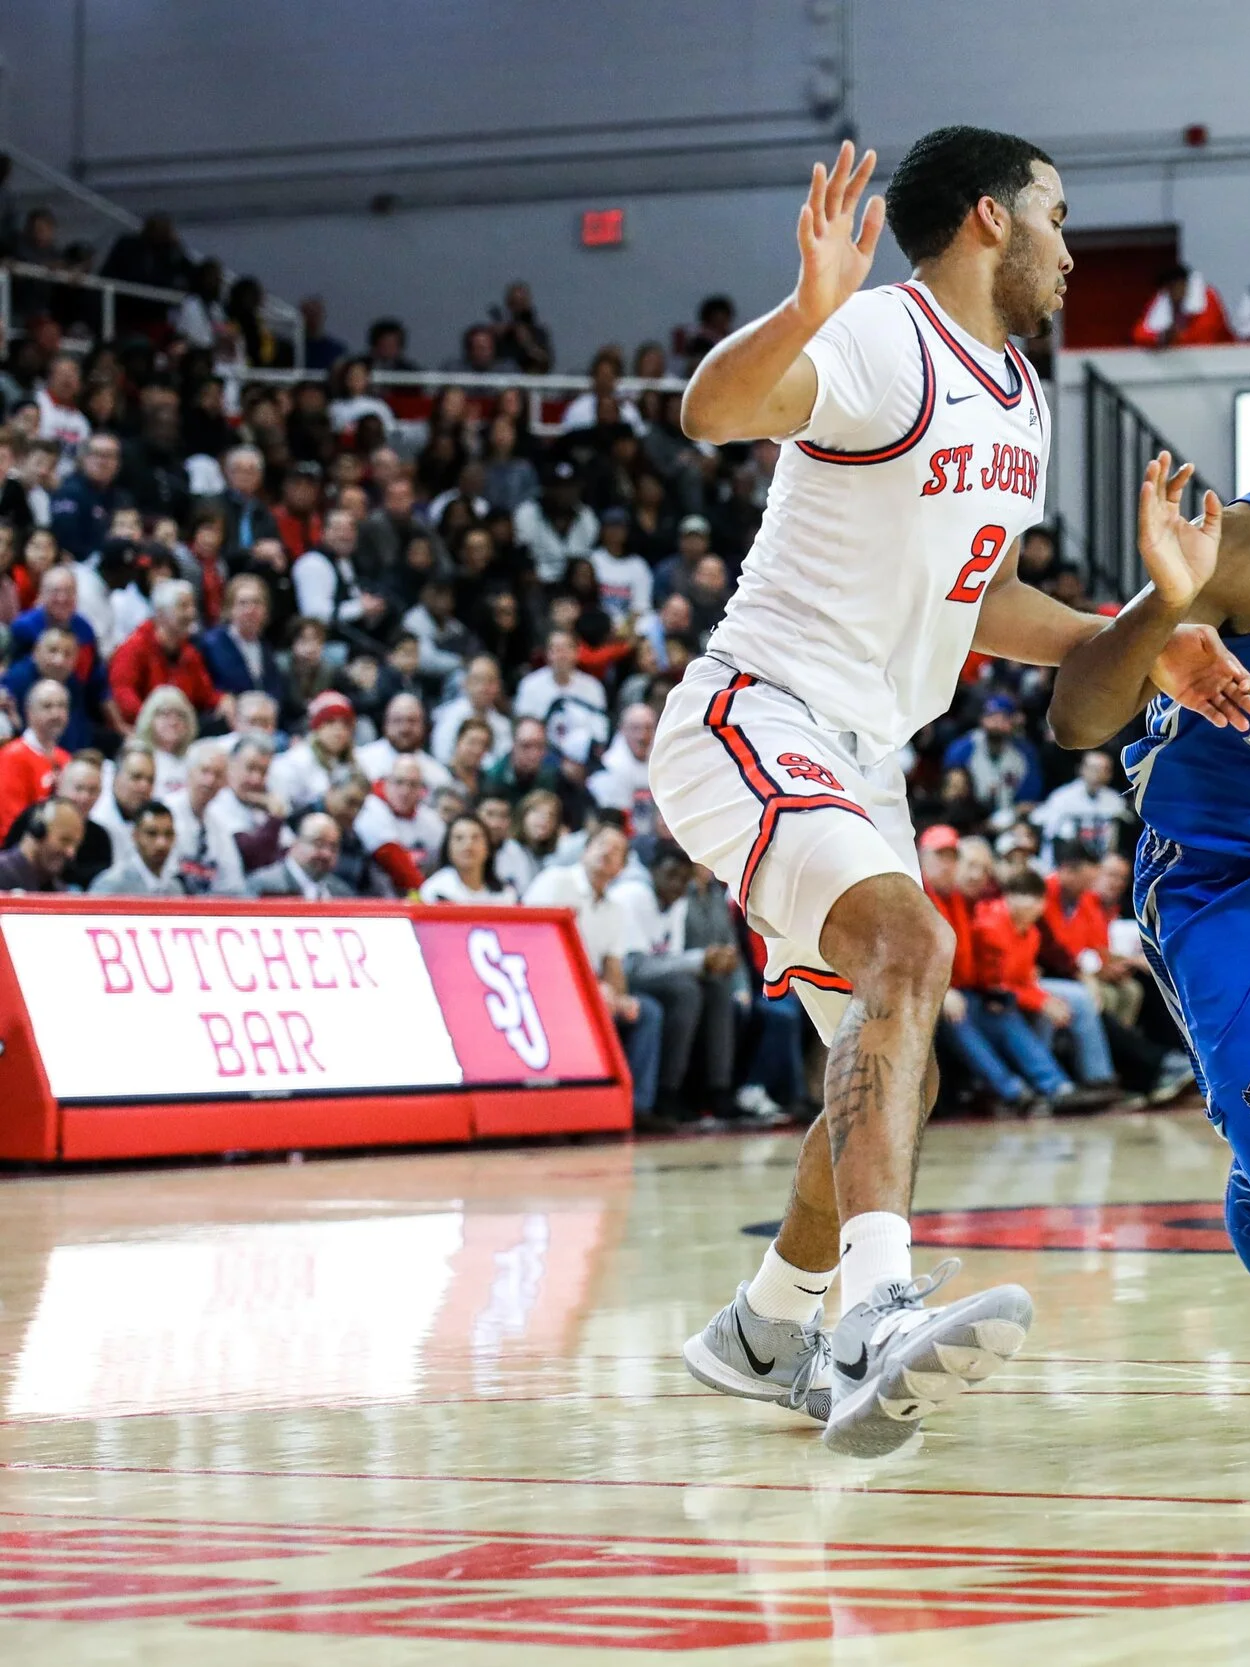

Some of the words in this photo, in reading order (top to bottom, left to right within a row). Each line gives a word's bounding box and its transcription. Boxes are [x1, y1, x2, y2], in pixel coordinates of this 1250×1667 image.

[920, 444, 973, 496] ST.
[945, 524, 1006, 604] 2
[84, 926, 378, 994] BUTCHER
[198, 1009, 326, 1077] BAR
